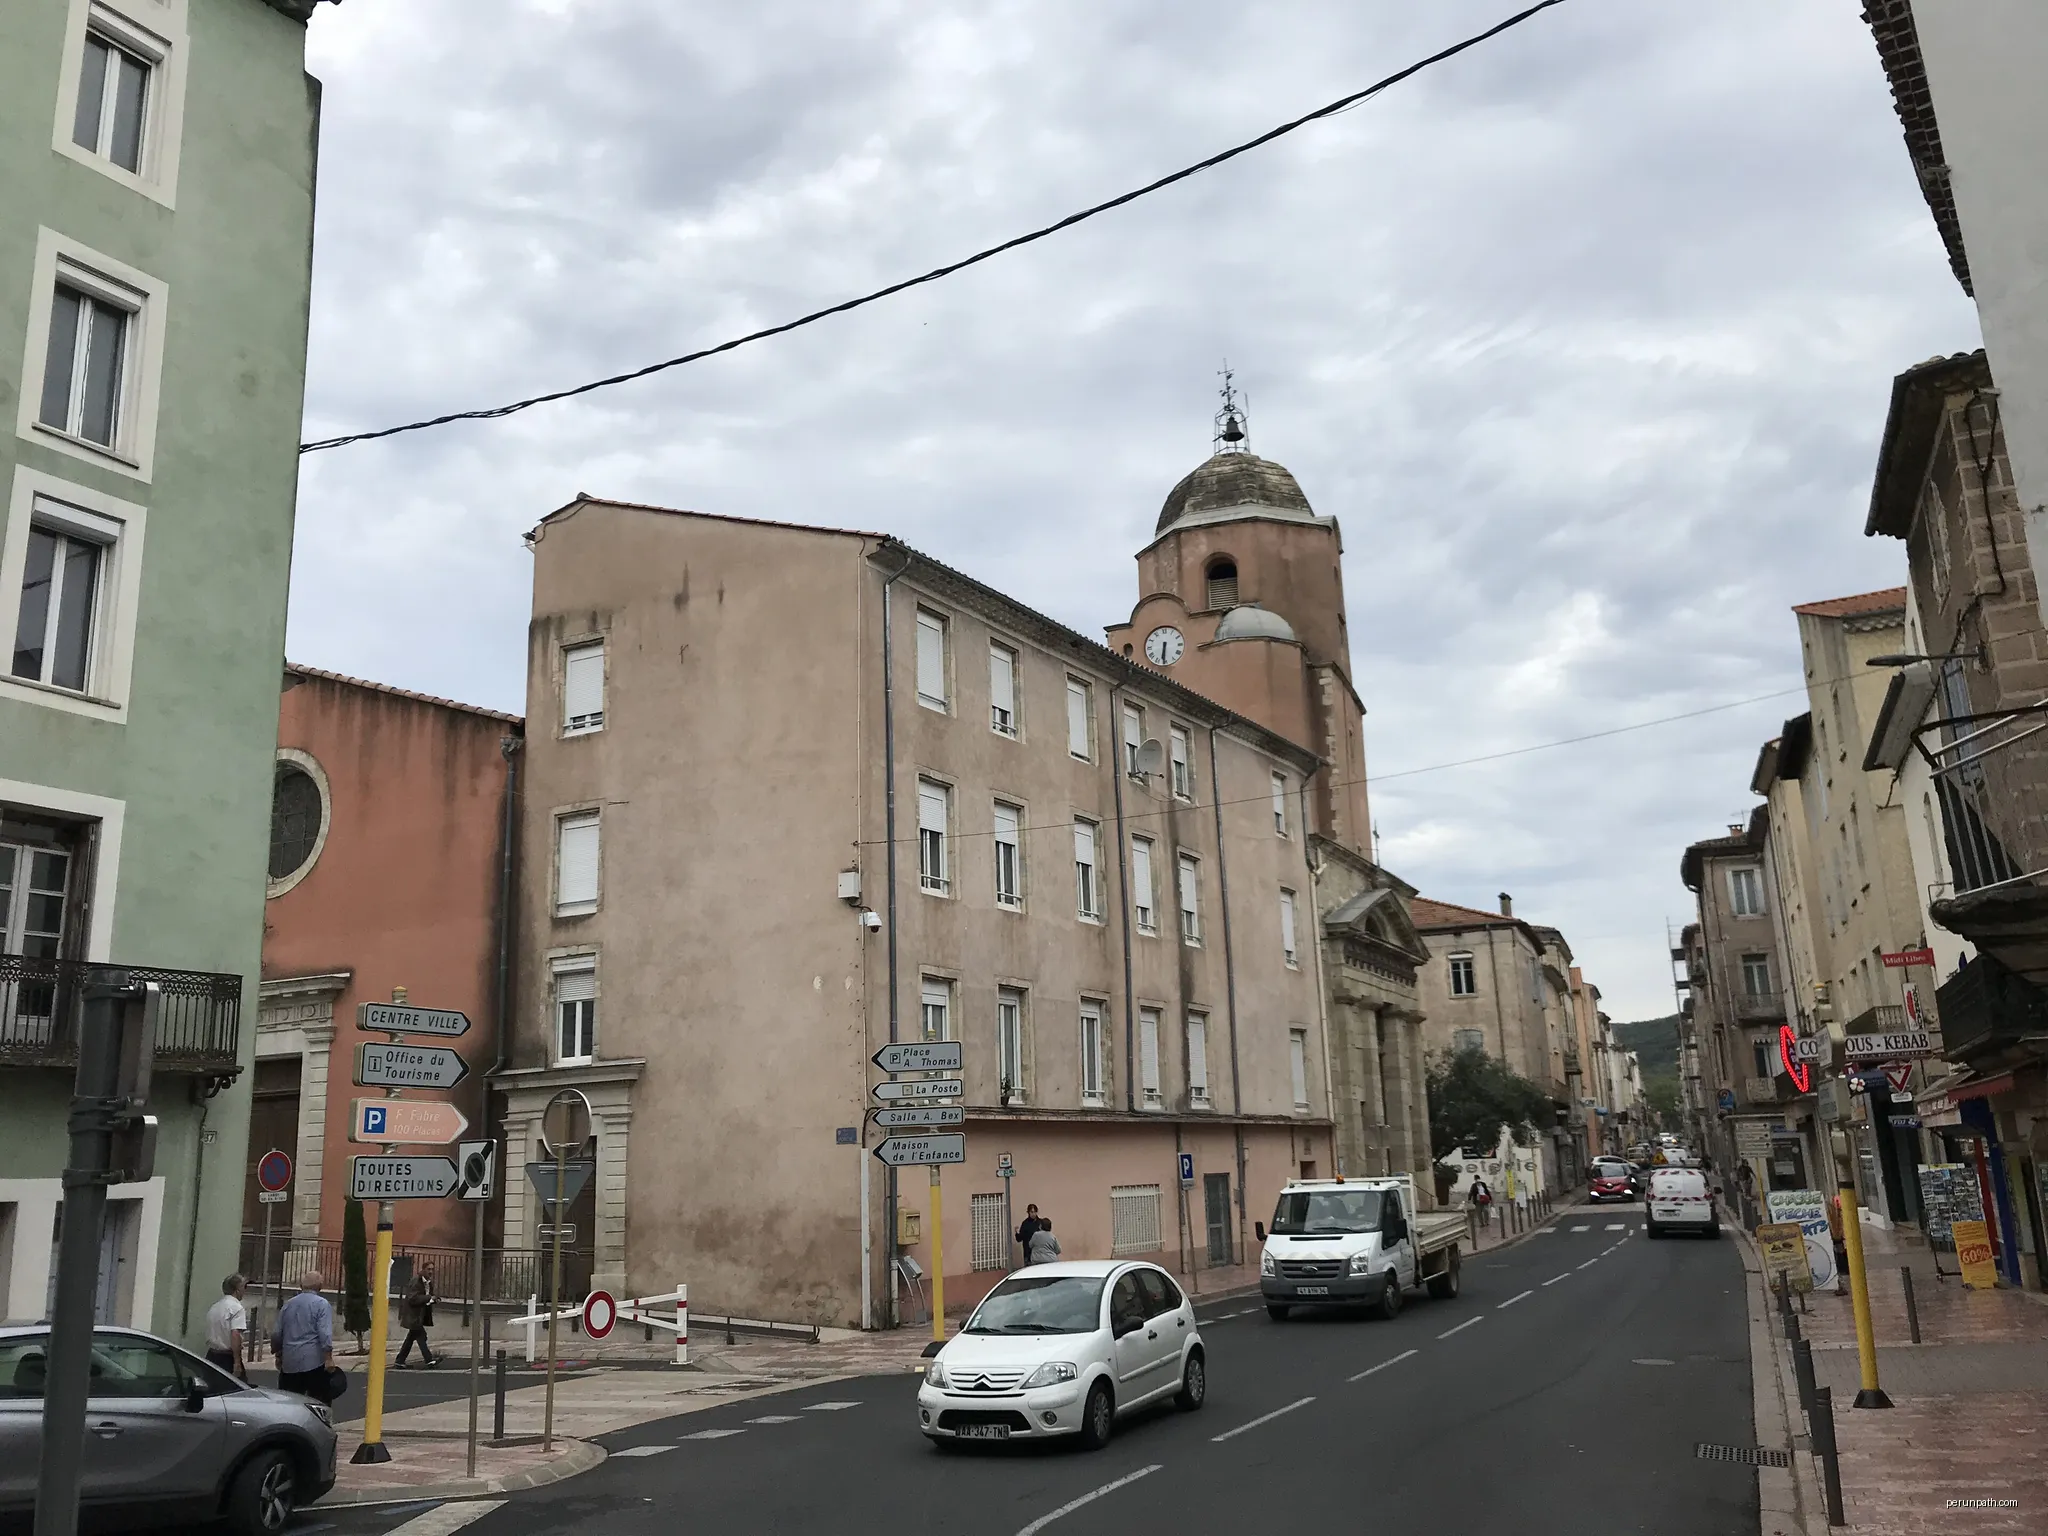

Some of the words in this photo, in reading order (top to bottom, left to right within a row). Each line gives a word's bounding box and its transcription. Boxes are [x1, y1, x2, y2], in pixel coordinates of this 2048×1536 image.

[1885, 956, 1904, 965] Midi
[1905, 955, 1926, 963] Libre
[370, 1010, 419, 1026] CENTRE
[428, 1015, 460, 1030] VILLE
[1885, 1034, 1929, 1051] KEBAB
[385, 1050, 424, 1065] Office
[430, 1053, 445, 1066] du
[903, 1048, 931, 1057] Place
[903, 1059, 913, 1068] A.
[921, 1057, 958, 1067] Thomas
[385, 1066, 441, 1081] Tourisme
[916, 1086, 927, 1094] La
[932, 1084, 959, 1093] Poste
[368, 1110, 382, 1130] P
[890, 1113, 917, 1122] Salle
[923, 1113, 933, 1121] A.
[941, 1111, 959, 1120] Bex
[891, 1141, 929, 1150] Maison
[892, 1152, 905, 1161] de
[912, 1150, 961, 1161] l'Enfance
[359, 1163, 413, 1176] TOUTES
[1183, 1158, 1190, 1175] P
[357, 1179, 444, 1193] DIRECTIONS
[1770, 1192, 1823, 1206] CHASSE
[1774, 1206, 1822, 1221] PECHE
[1962, 1247, 1990, 1264] 60%
